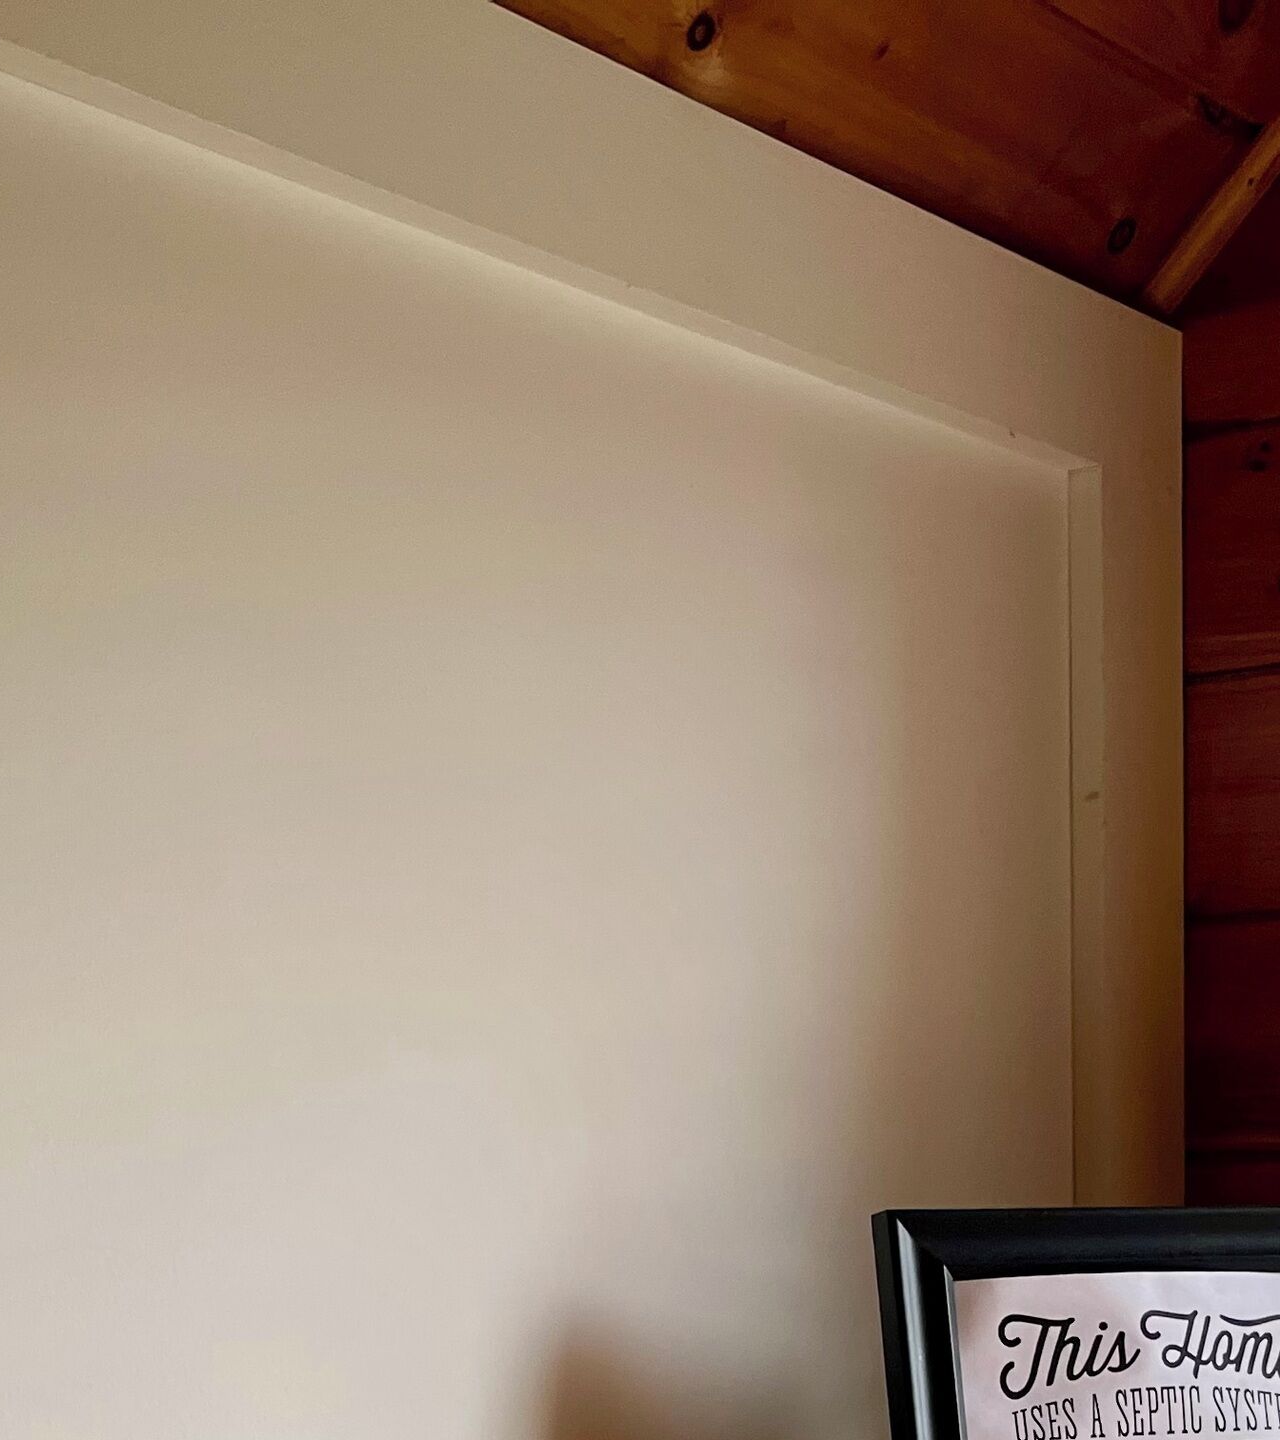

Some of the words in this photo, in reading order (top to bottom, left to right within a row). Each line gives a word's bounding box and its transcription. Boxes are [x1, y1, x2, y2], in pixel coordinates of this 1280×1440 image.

[998, 1313, 1140, 1399] This
[1090, 1394, 1106, 1438] A
[1116, 1386, 1203, 1437] SEPTIC
